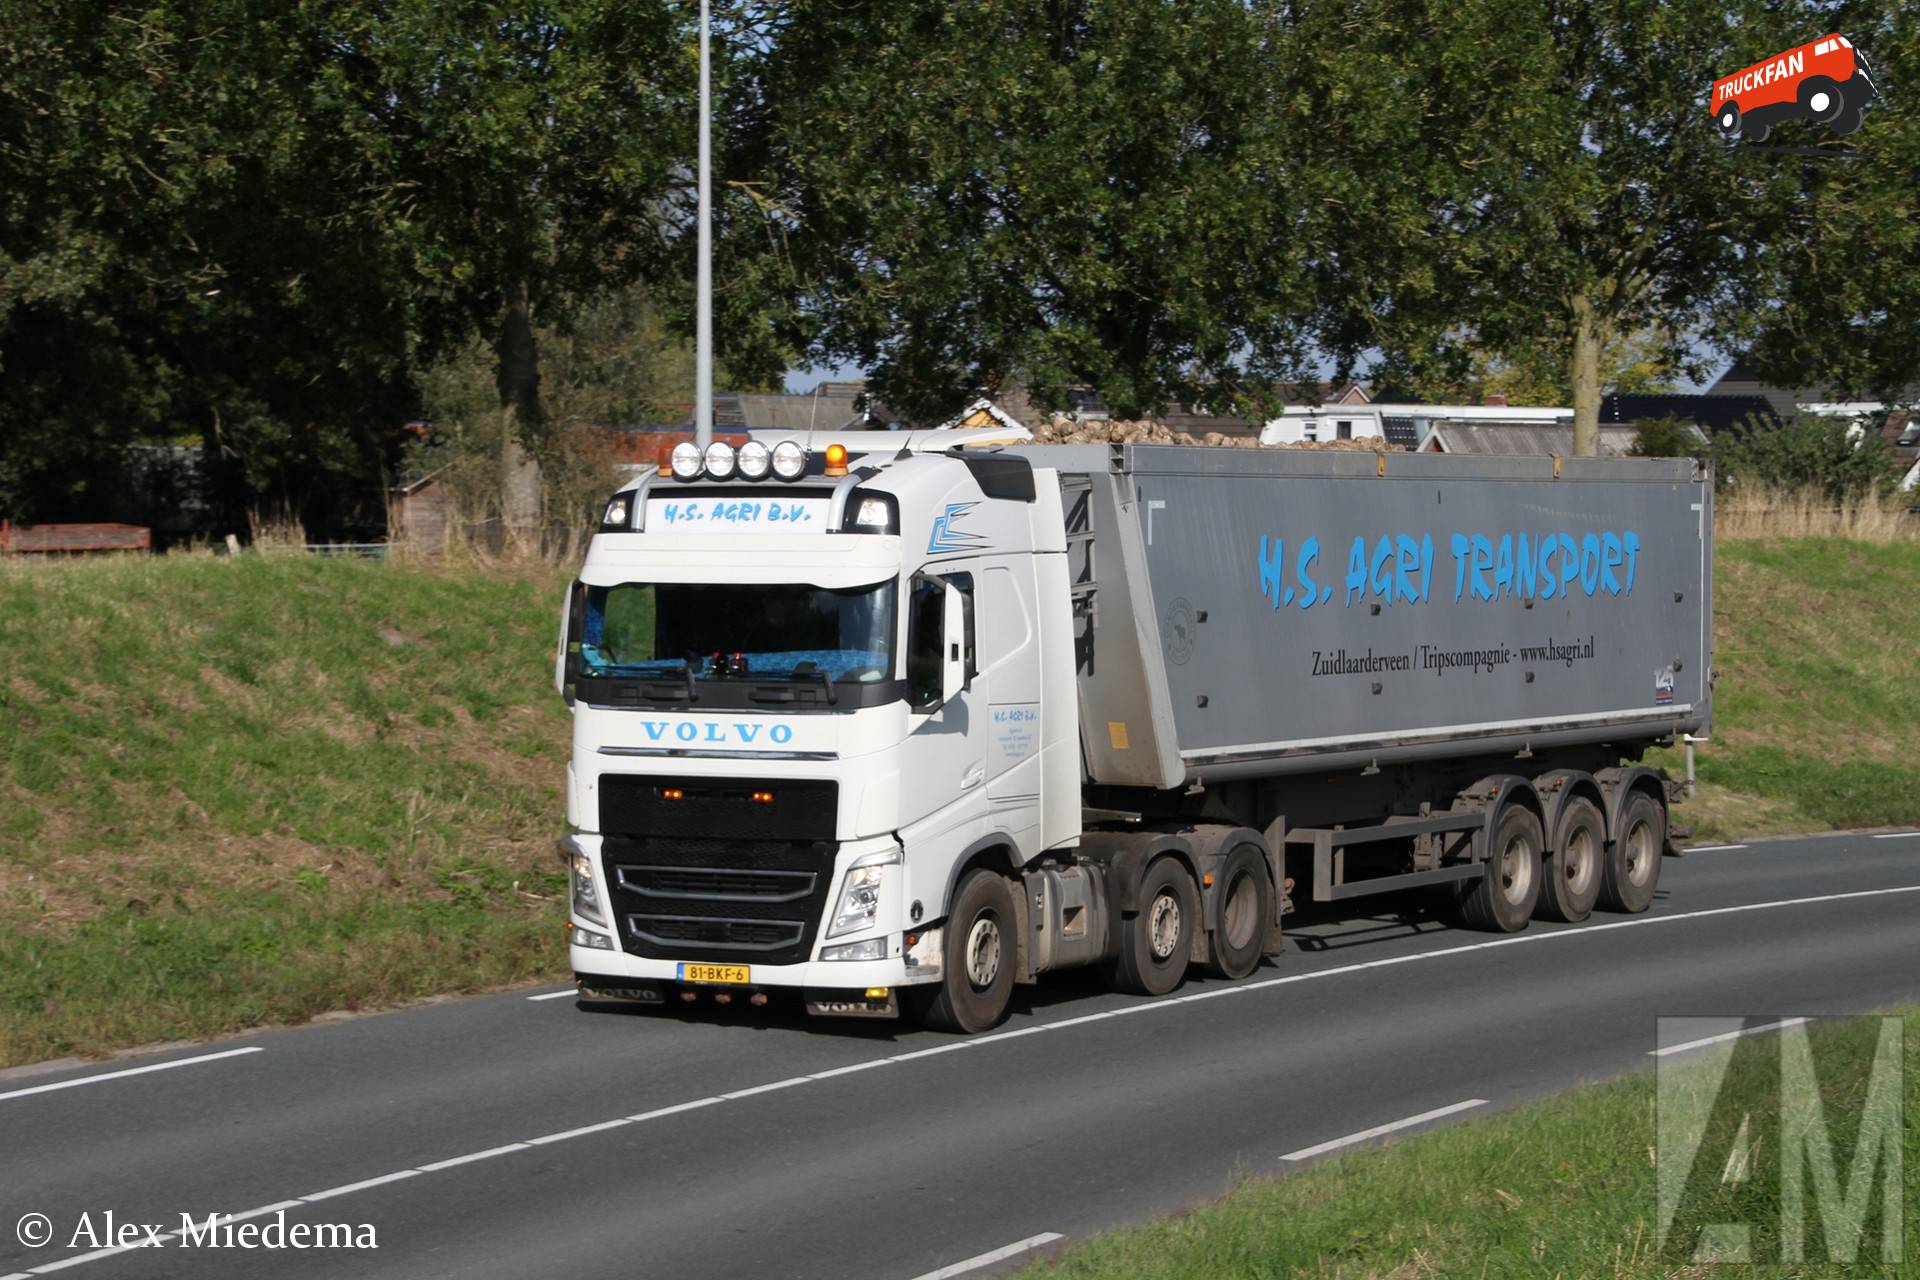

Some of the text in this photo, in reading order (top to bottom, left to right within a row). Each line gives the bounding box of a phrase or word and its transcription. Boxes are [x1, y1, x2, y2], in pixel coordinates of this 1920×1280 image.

[664, 502, 812, 524] H.S. AGRI B.V.
[1258, 531, 1640, 612] H.S. AGRI TRANSPORT
[1312, 648, 1410, 676] Zuidlaarderveen
[1420, 643, 1510, 676] Tripscompagnie
[1520, 635, 1595, 667] www.hsagri.nl
[640, 721, 793, 744] VOLVO
[690, 967, 743, 980] 81-BKF-6
